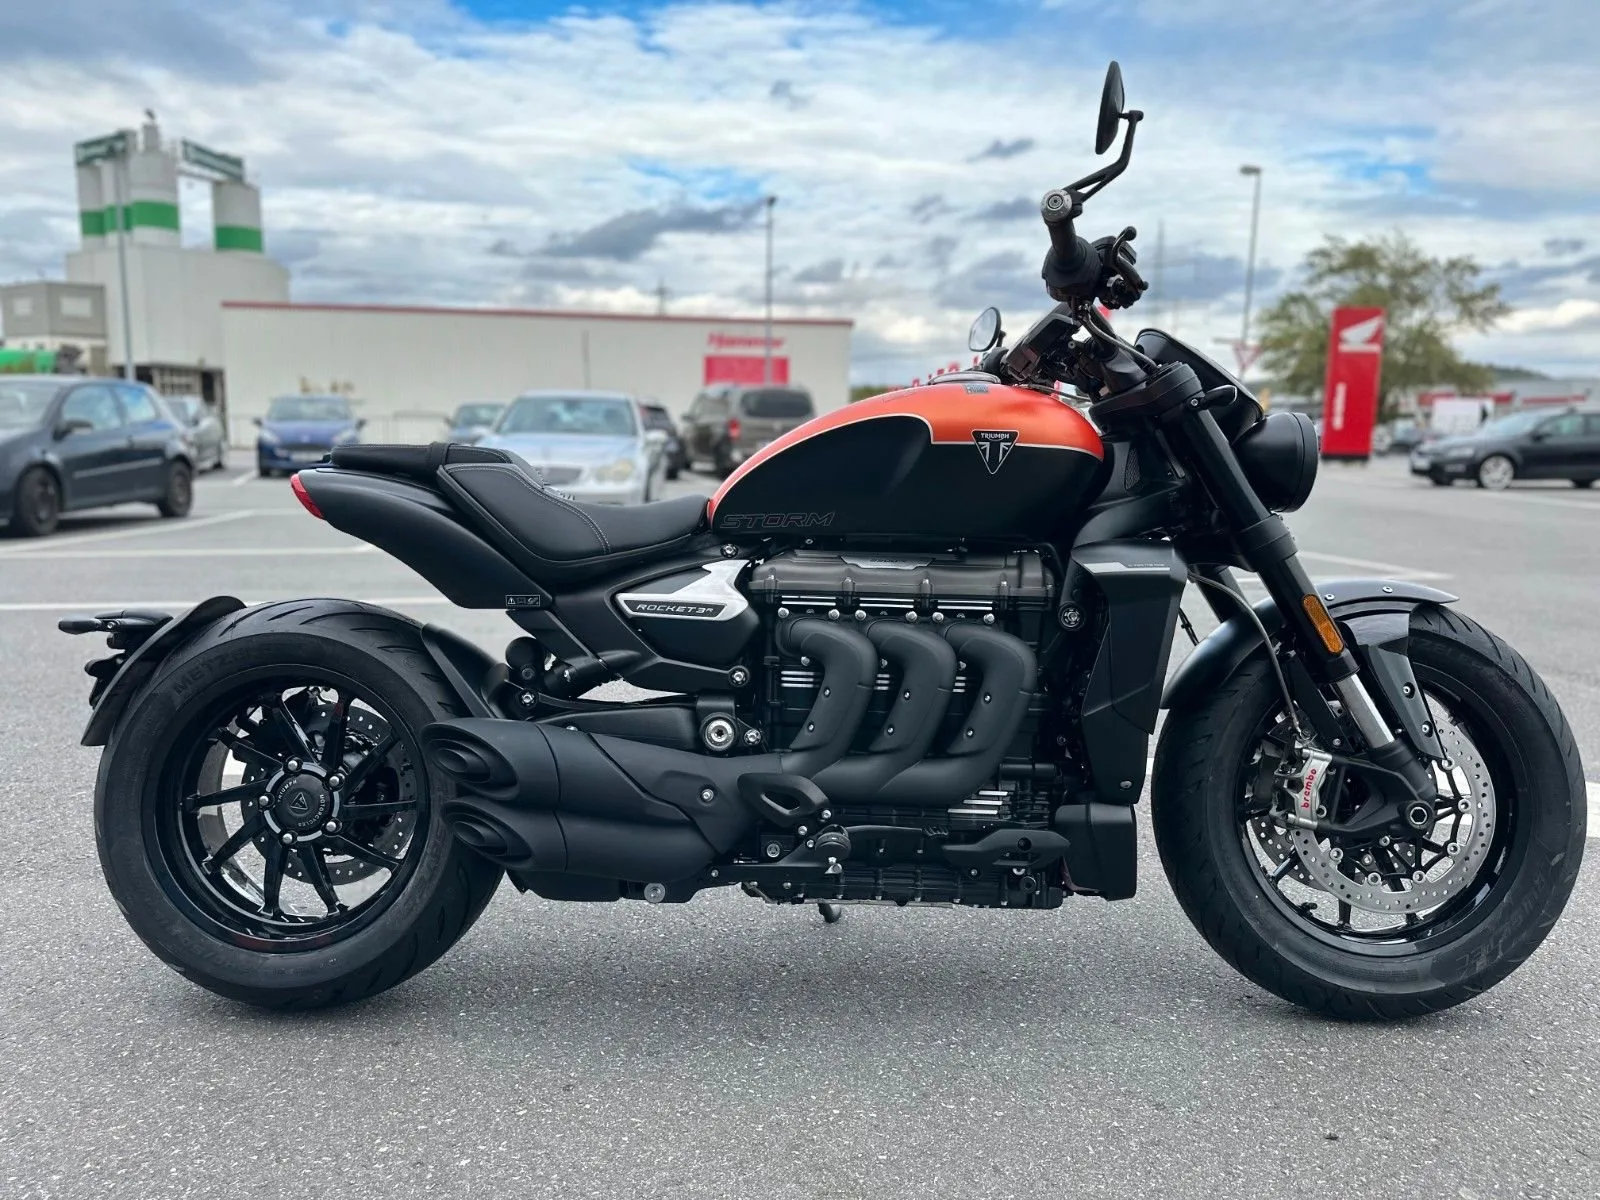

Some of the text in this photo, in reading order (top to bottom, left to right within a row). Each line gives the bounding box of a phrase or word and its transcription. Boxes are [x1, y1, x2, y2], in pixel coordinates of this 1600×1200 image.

[980, 432, 1010, 440] TRIUMPH
[720, 510, 836, 528] STORM
[277, 779, 297, 803] TRIUMPH
[1301, 768, 1317, 809] brembo
